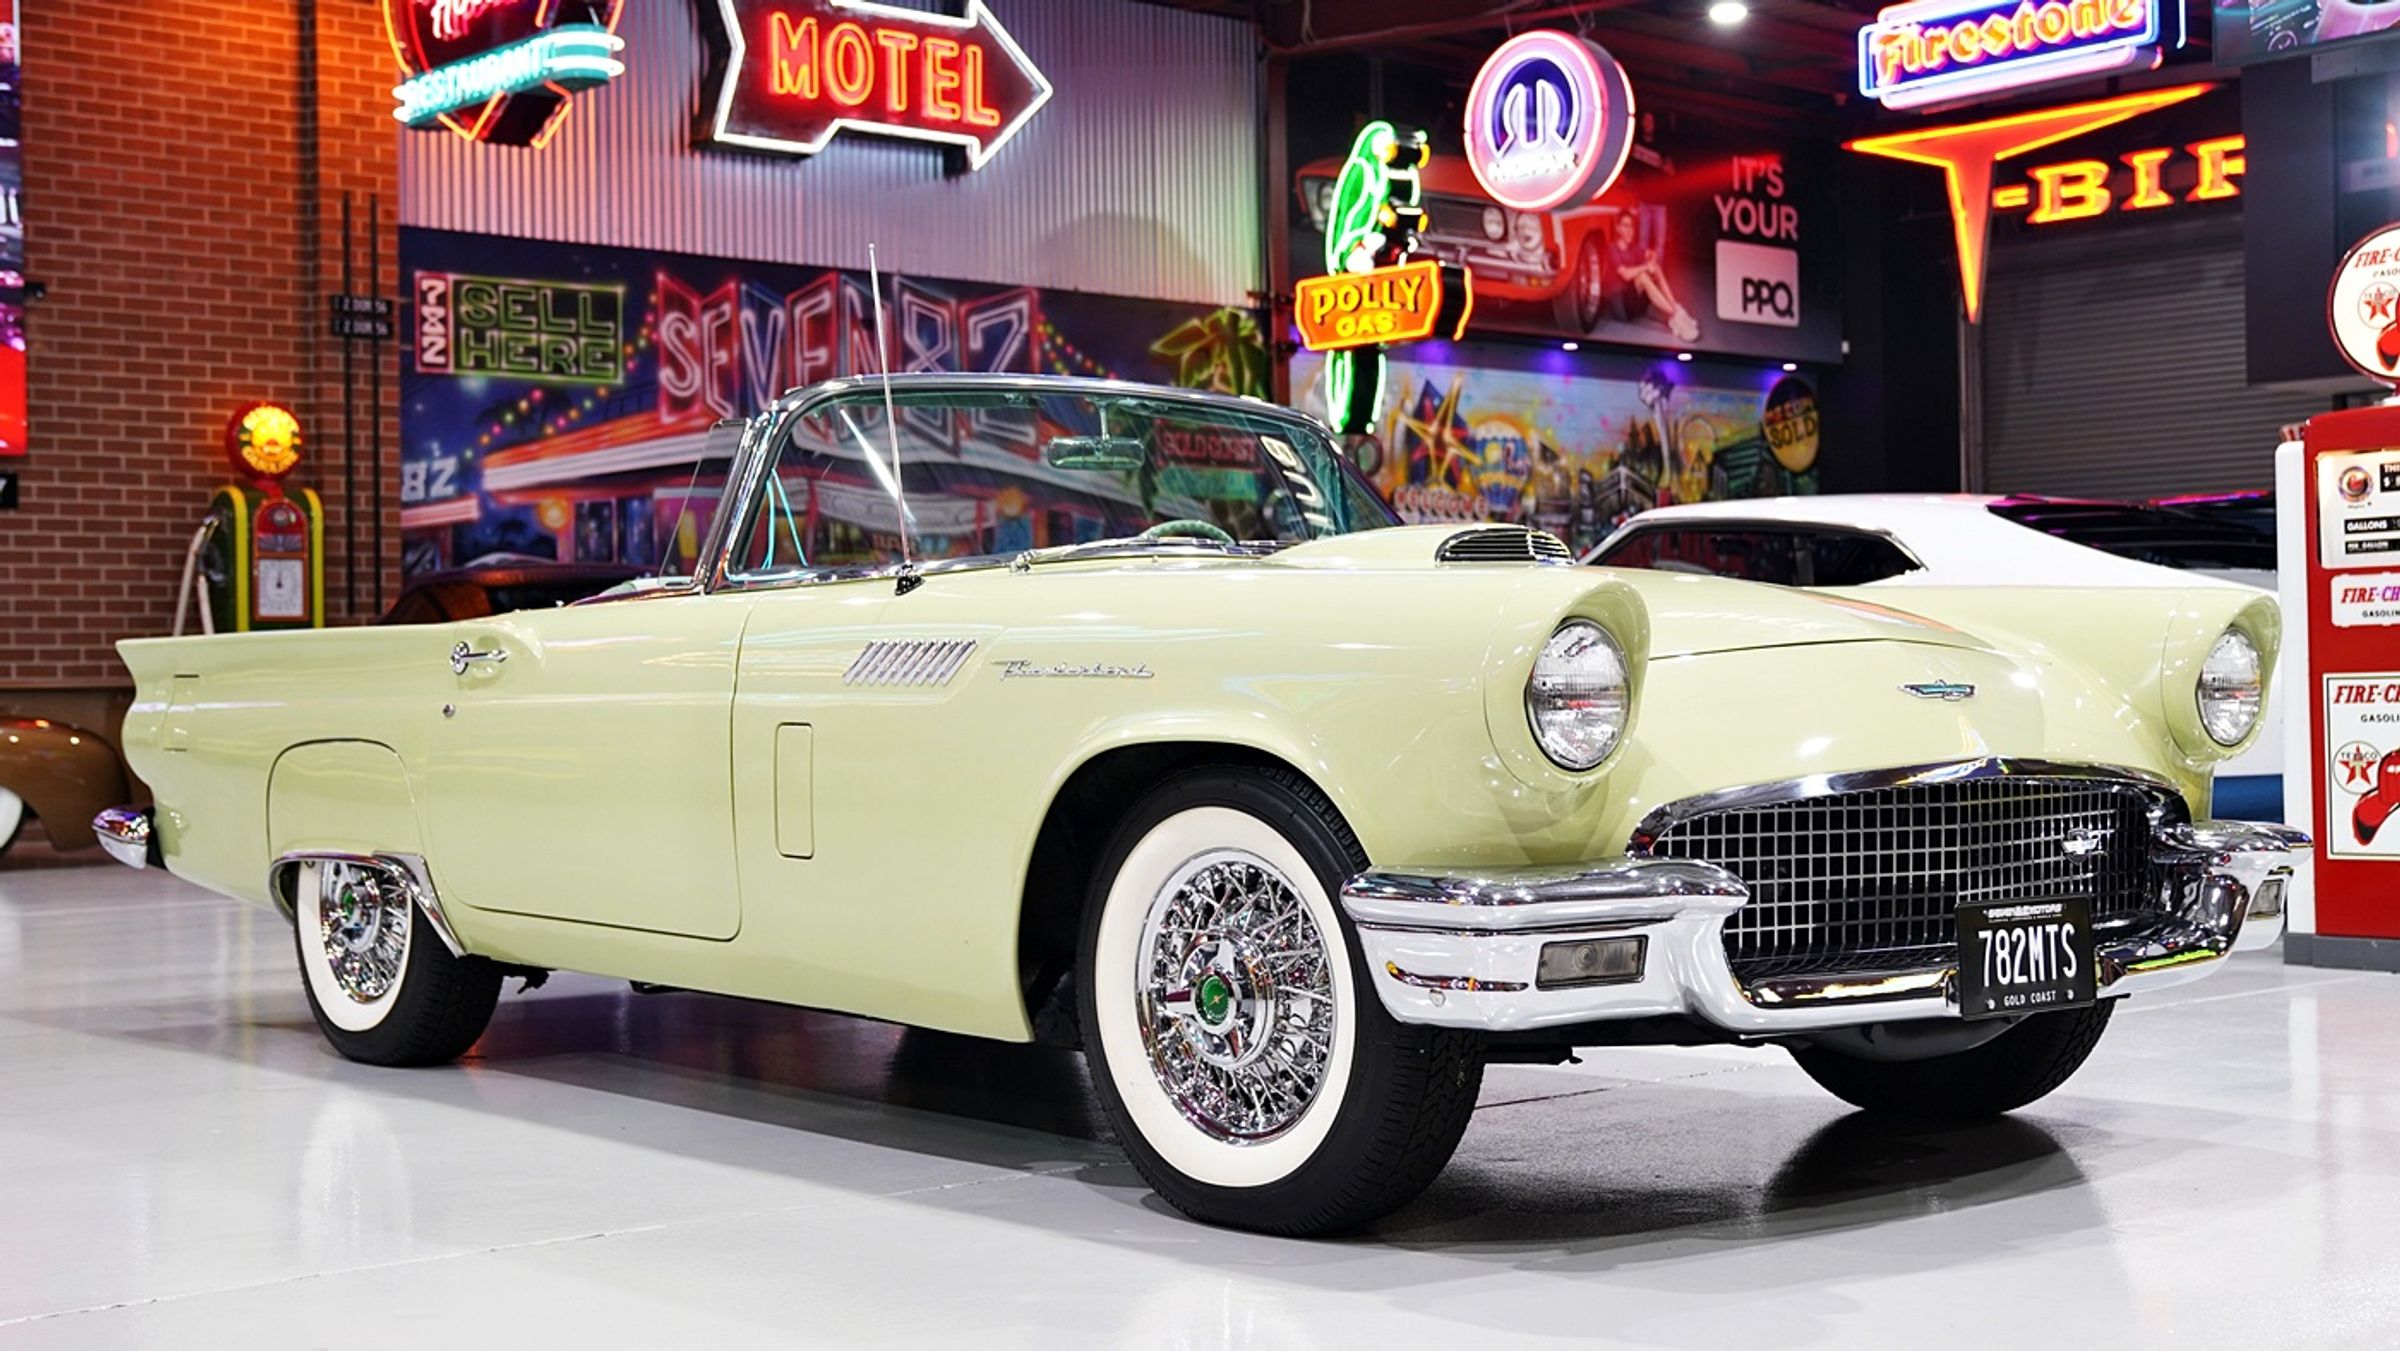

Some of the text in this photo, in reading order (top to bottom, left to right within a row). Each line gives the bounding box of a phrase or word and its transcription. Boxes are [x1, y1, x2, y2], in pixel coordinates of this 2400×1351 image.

[1870, 0, 2146, 86] Firestone
[771, 11, 1000, 126] MOTEL
[1731, 156, 1785, 197] IT'S
[1714, 194, 1799, 240] YOUR
[459, 283, 616, 336] SELL
[1310, 275, 1424, 324] POLLY
[1742, 277, 1795, 319] PPQ
[1335, 311, 1395, 338] GAS
[459, 328, 617, 376] HERE
[1770, 415, 1817, 448] SOLD
[2346, 520, 2388, 531] GALLONS
[1978, 922, 2077, 988] 782MTS
[2004, 990, 2057, 1007] GOLD COAST
